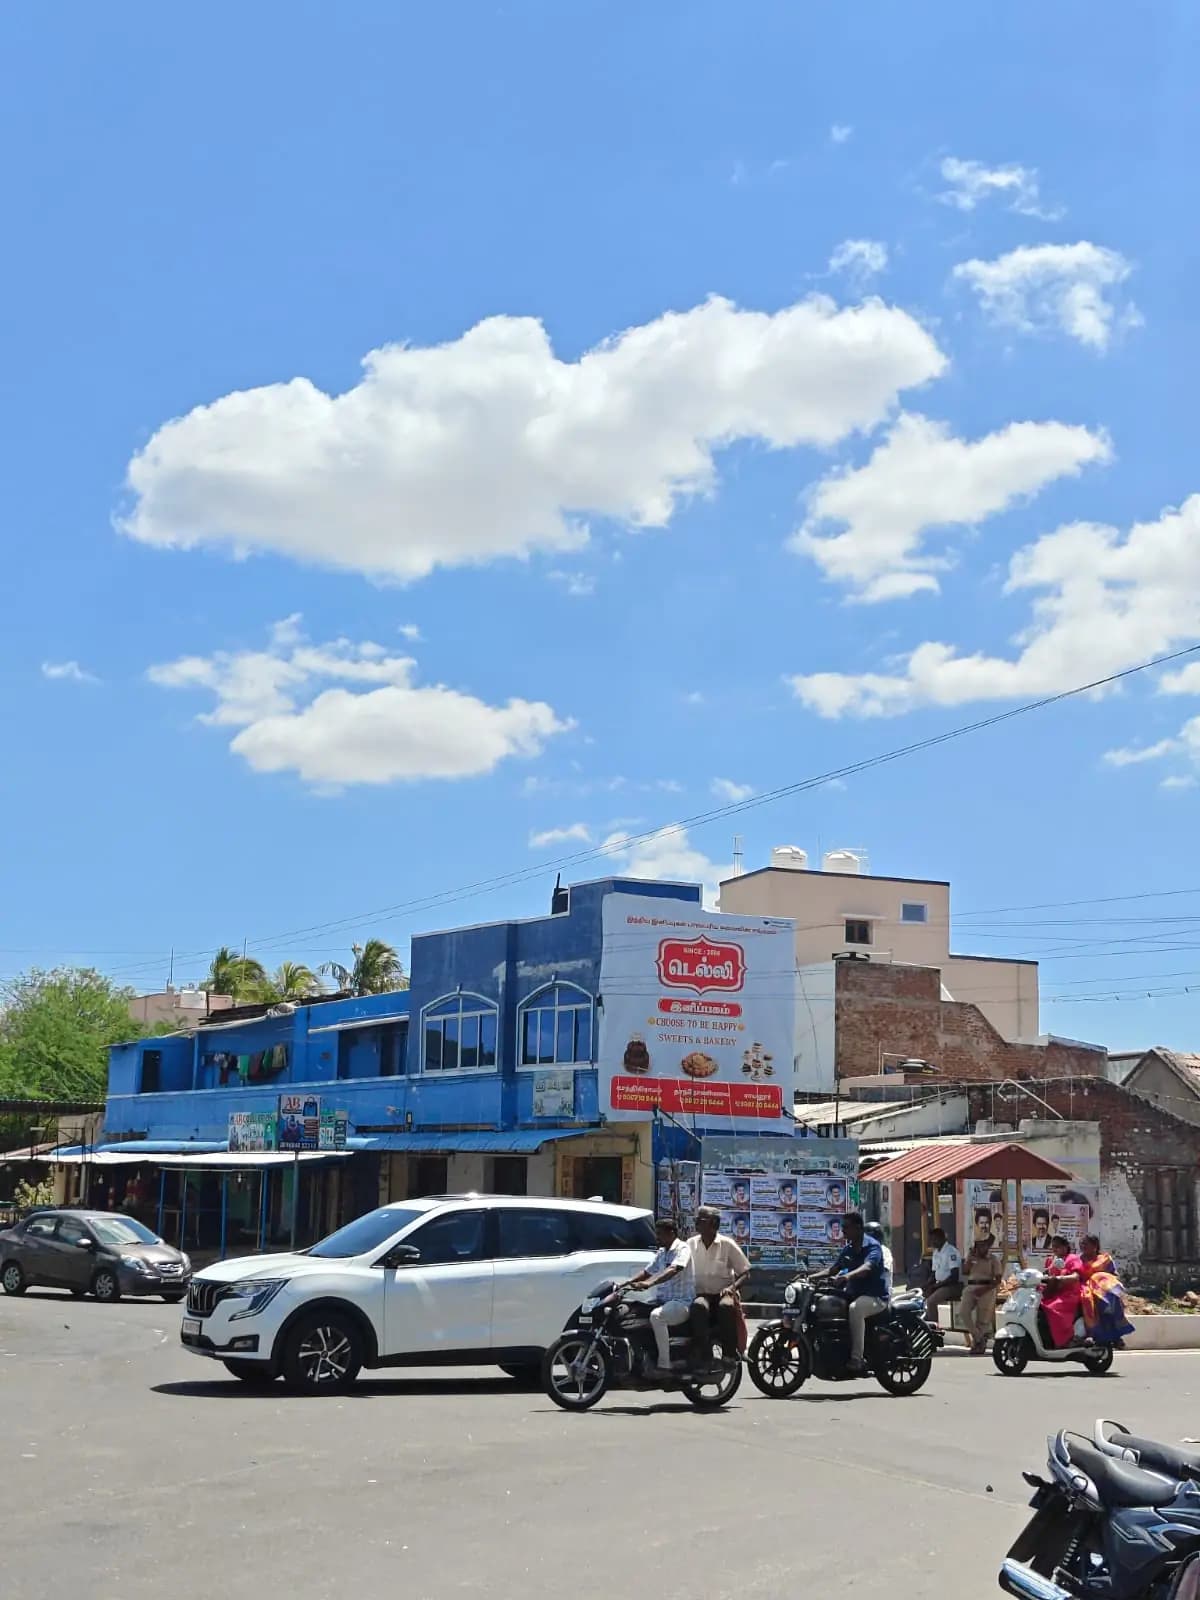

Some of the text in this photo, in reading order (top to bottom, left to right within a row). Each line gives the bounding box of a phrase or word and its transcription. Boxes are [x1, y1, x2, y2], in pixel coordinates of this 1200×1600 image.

[668, 956, 734, 980] டெல்லி
[656, 1018, 738, 1031] CHOOSE TO BE HAPPY
[658, 1034, 694, 1044] SWEETS
[704, 1036, 736, 1046] BAKERY
[286, 1097, 300, 1109] AB
